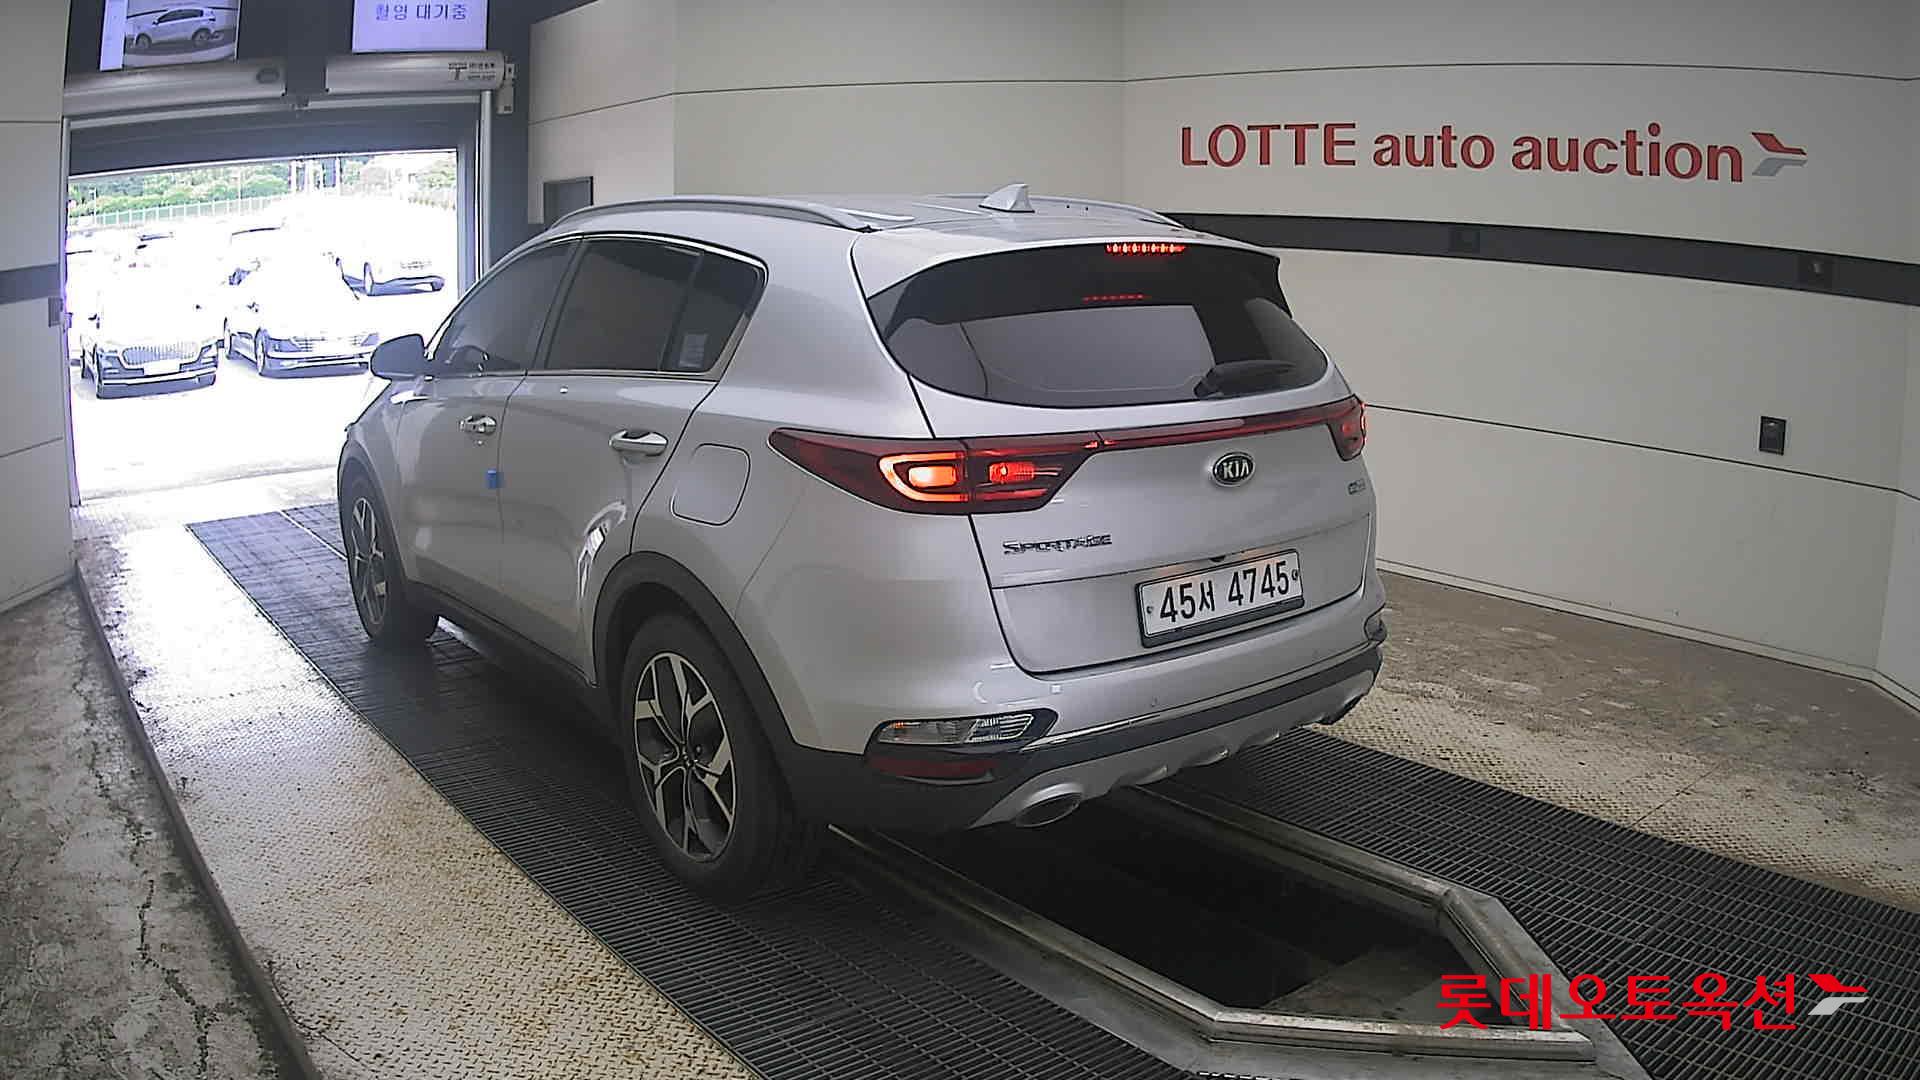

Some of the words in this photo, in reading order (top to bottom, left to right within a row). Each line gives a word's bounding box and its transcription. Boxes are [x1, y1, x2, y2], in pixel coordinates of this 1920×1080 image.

[1182, 123, 1357, 166] LOTTE
[1373, 125, 1495, 170] auto
[1511, 122, 1743, 182] auction
[1222, 459, 1250, 479] KIA
[1159, 579, 1216, 622] 45서
[1227, 560, 1290, 606] 4745
